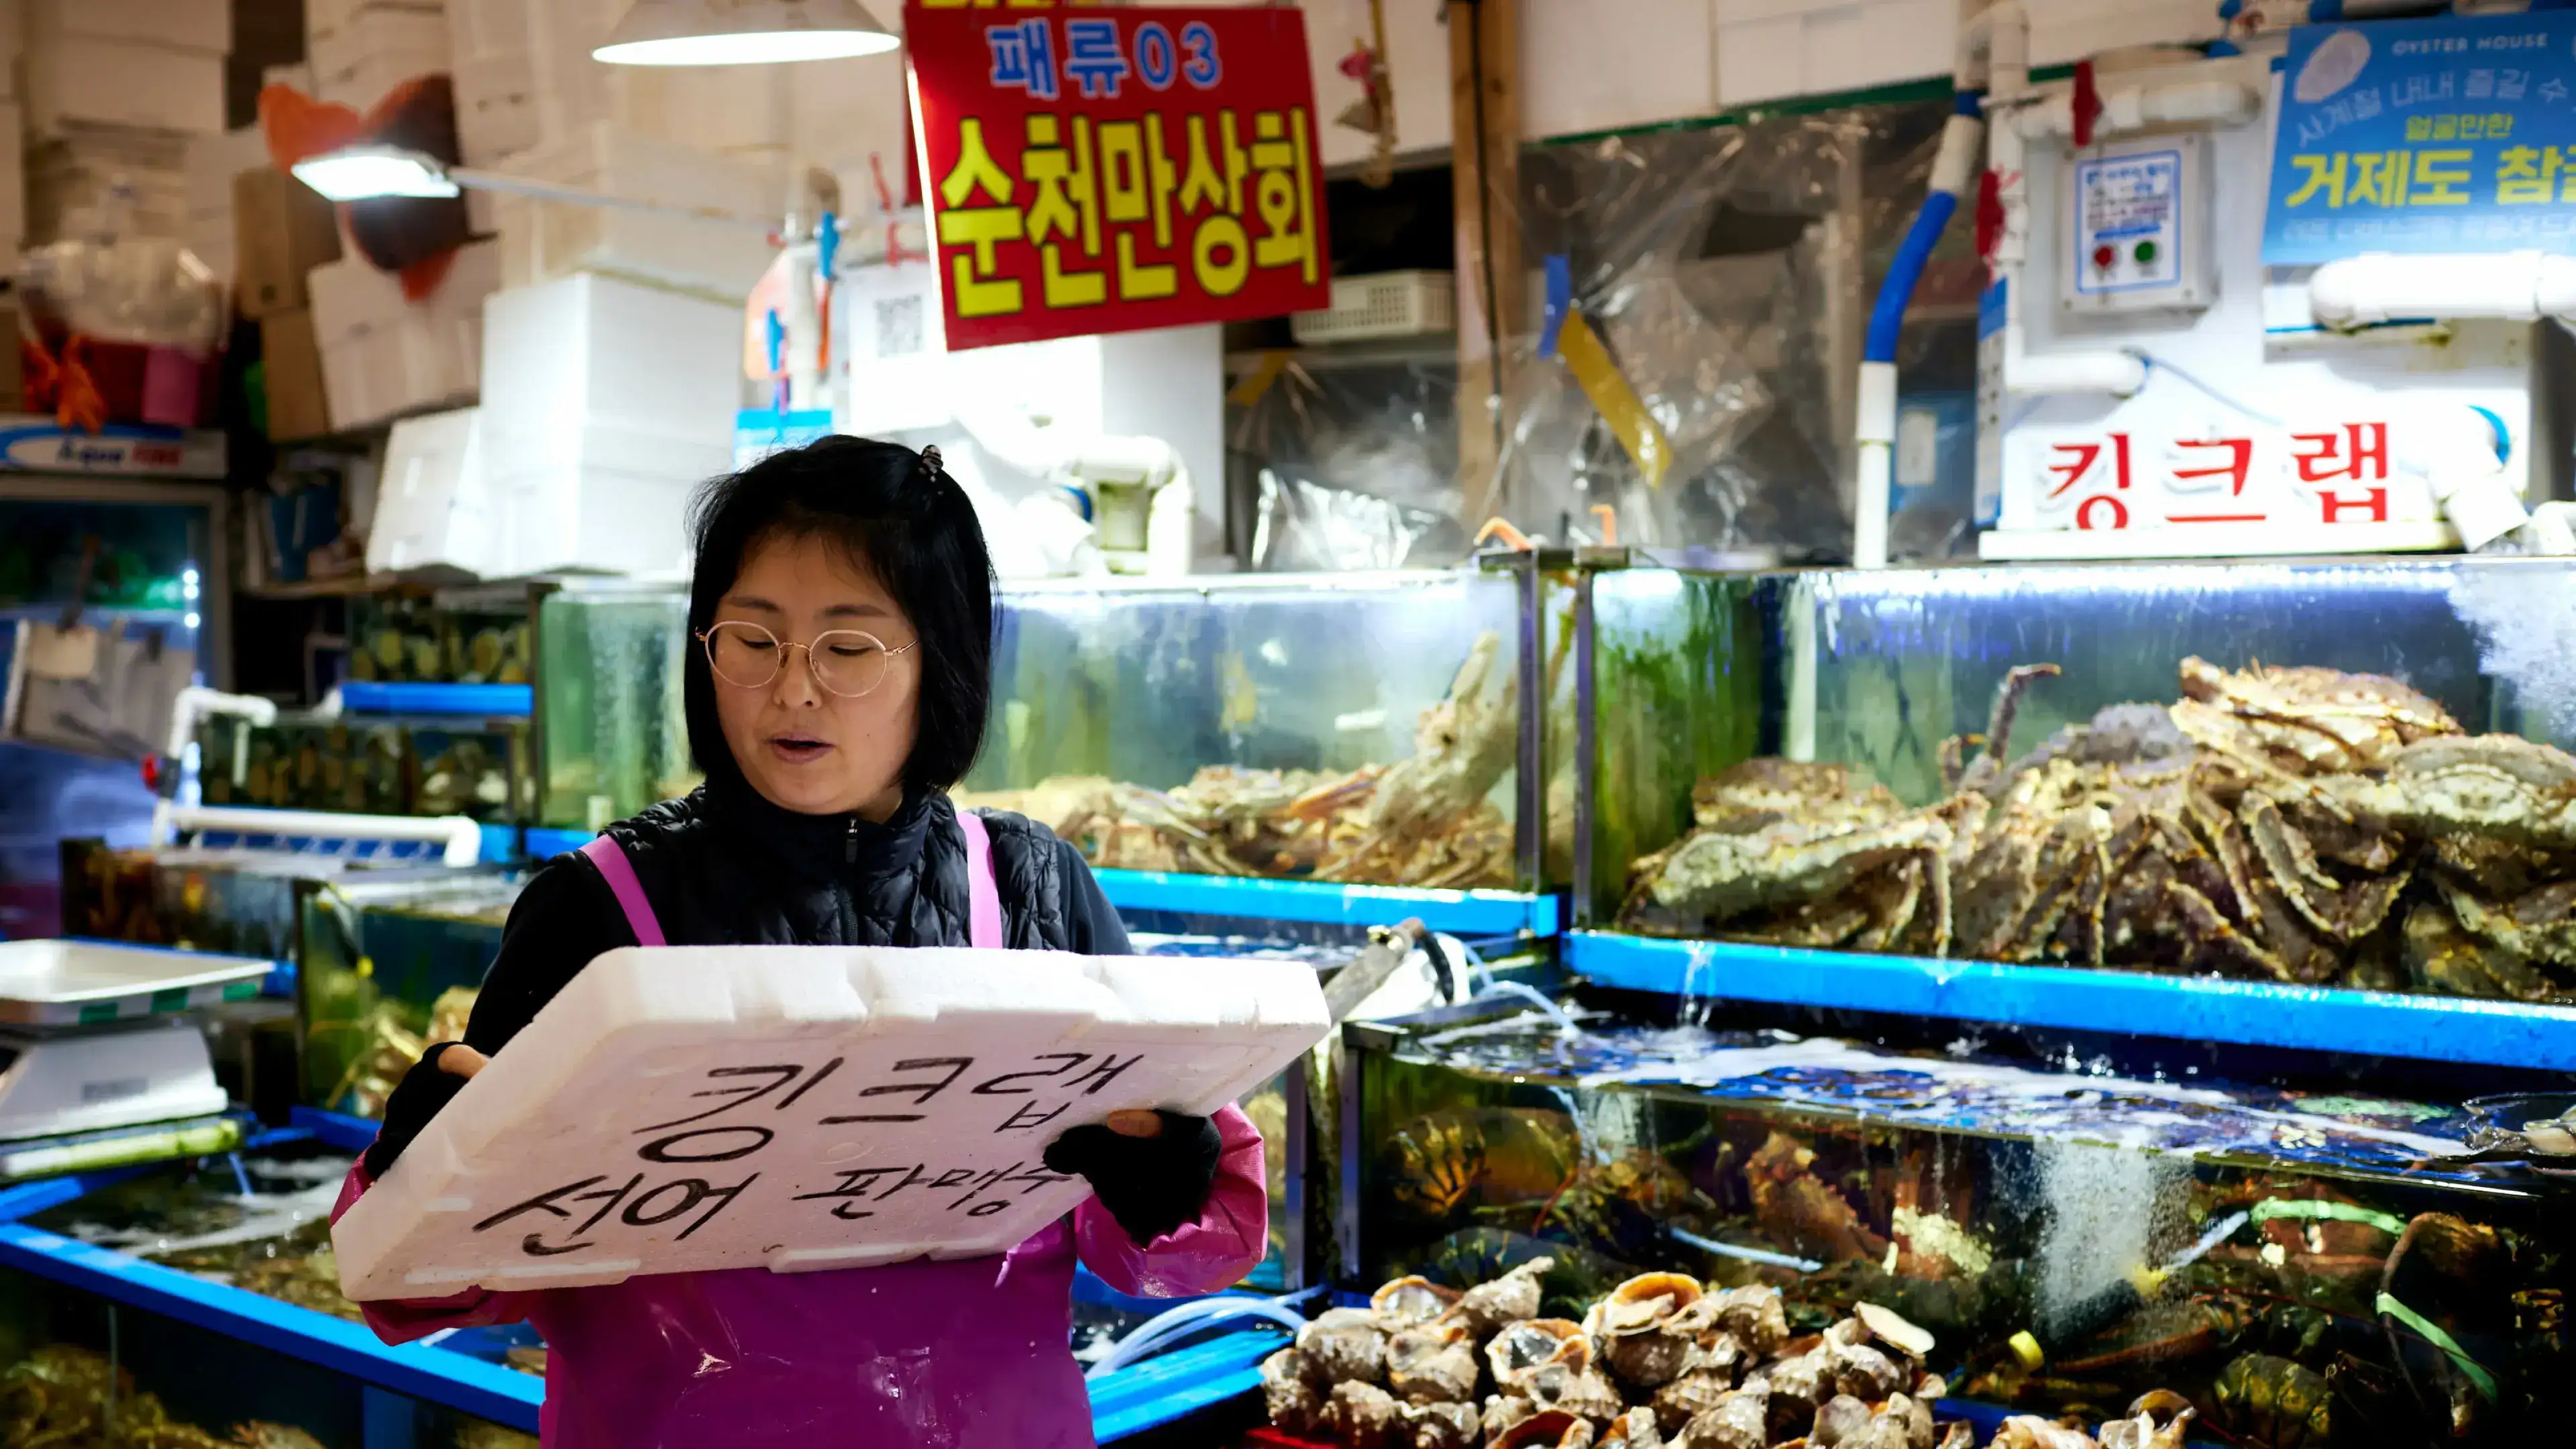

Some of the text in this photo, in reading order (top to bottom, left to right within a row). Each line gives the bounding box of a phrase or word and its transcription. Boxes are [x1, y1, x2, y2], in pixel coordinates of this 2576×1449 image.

[2392, 32, 2548, 56] OYSTER HOUSE
[2390, 70, 2455, 108] 내내
[2405, 112, 2514, 142] 얼굴만한
[938, 105, 1320, 319] 순천만상회
[2284, 144, 2576, 208] 거제도 참
[2048, 422, 2387, 530] 킹크랩
[632, 1052, 1144, 1163] 킹크랩
[472, 1172, 763, 1256] 선어
